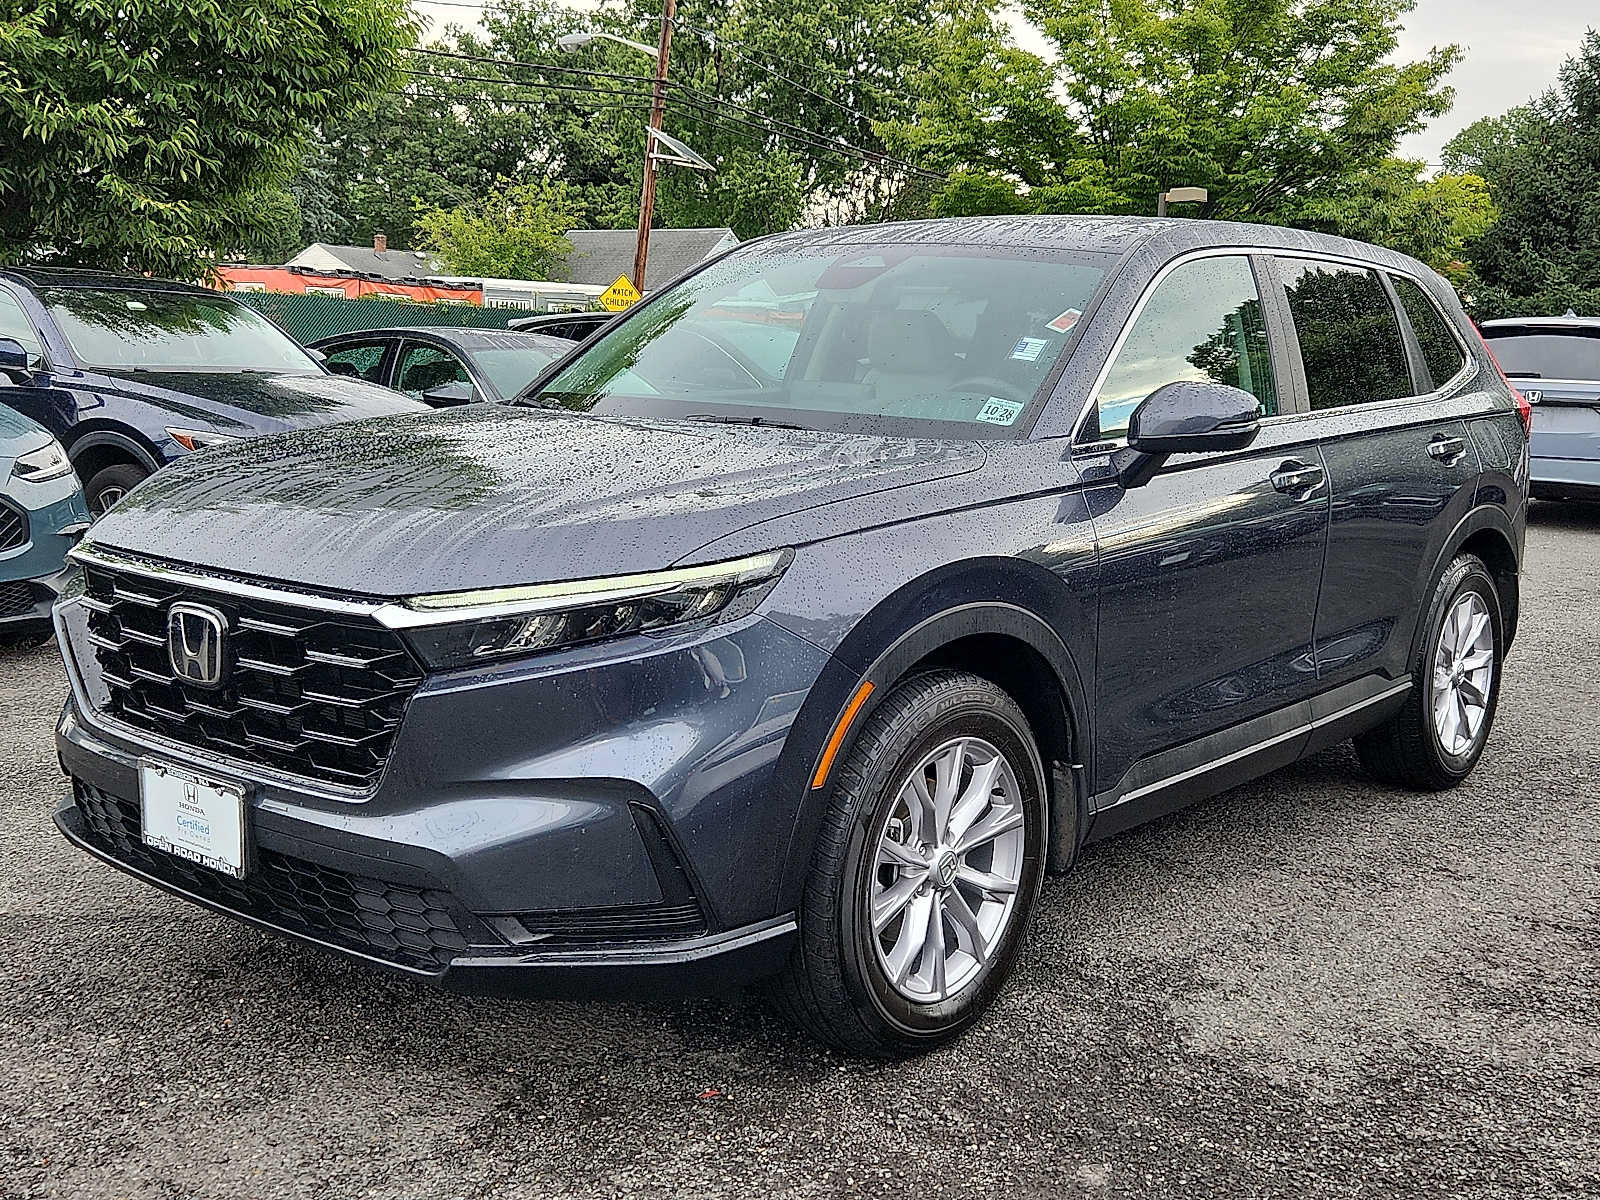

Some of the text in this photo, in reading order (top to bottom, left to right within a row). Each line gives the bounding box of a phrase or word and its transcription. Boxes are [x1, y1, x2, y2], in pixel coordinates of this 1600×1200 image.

[612, 288, 633, 297] WATCH
[984, 405, 999, 415] 10
[999, 409, 1015, 419] 28
[178, 801, 206, 816] HONDA
[176, 815, 210, 835] Certified
[146, 835, 173, 853] OPEN
[173, 846, 201, 864] ROAD
[202, 856, 239, 879] HONDA
